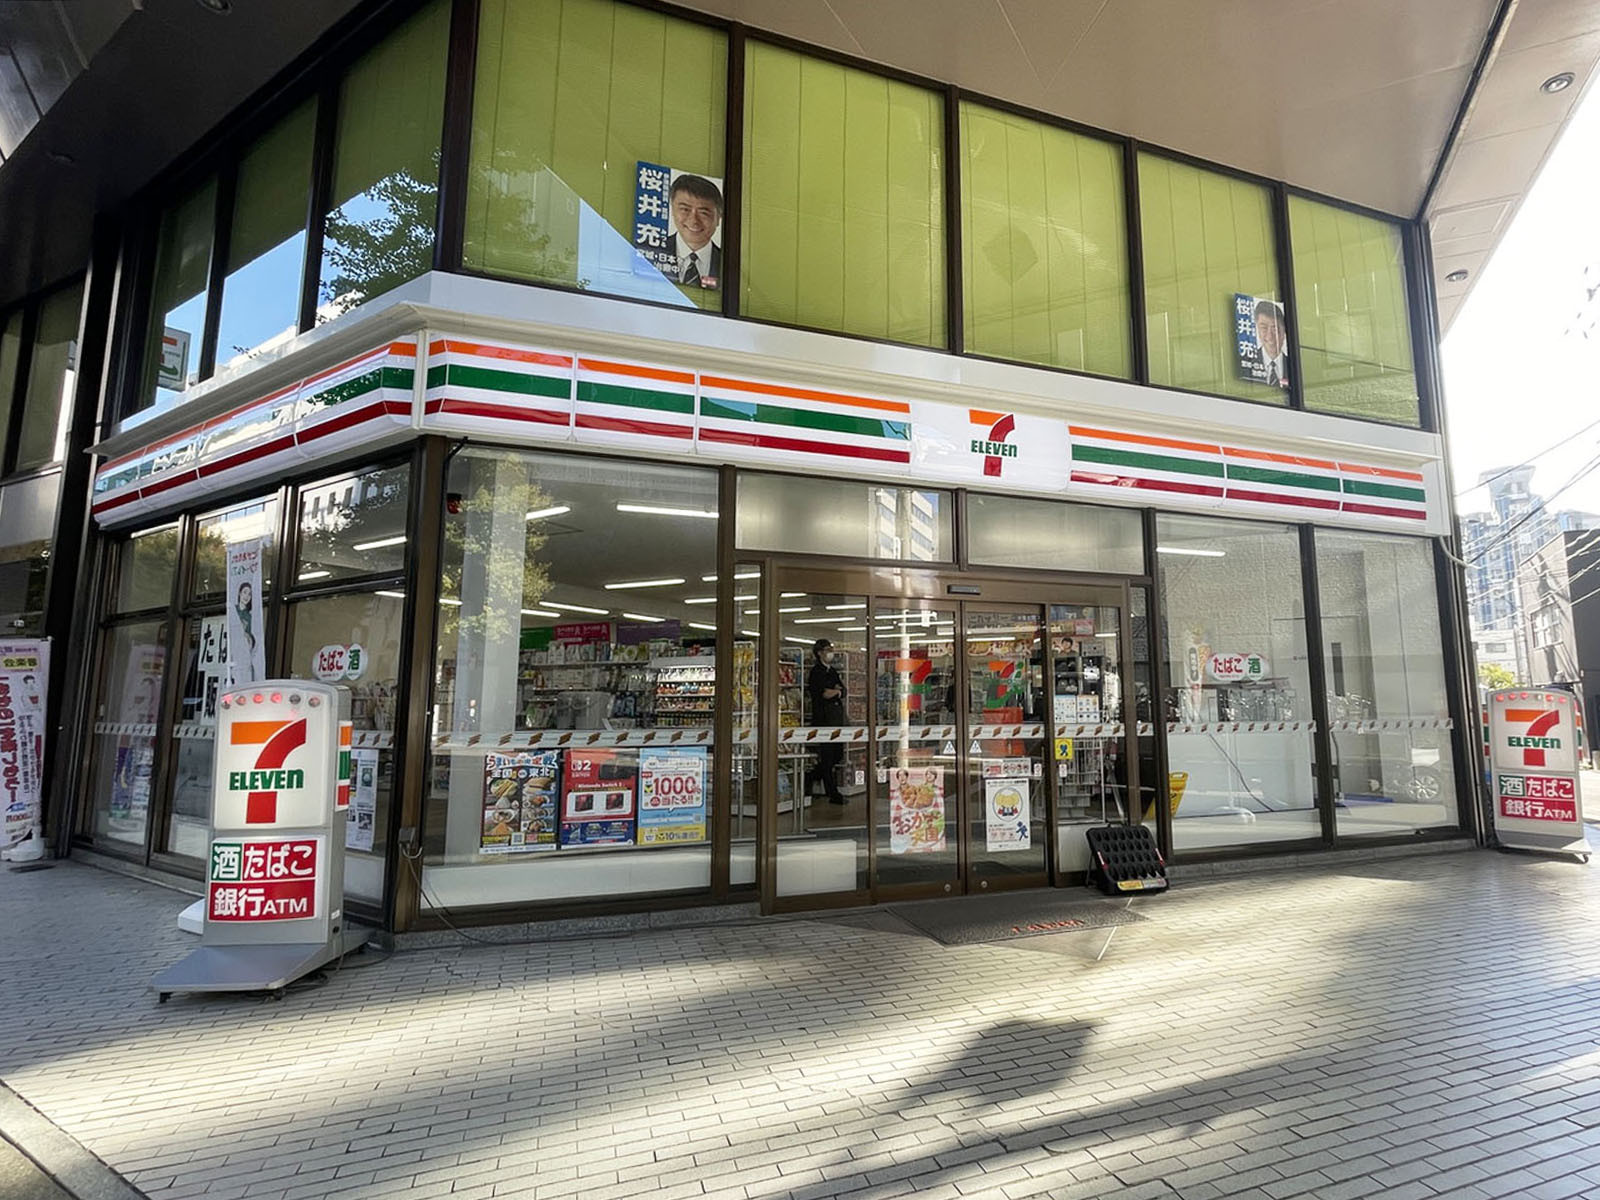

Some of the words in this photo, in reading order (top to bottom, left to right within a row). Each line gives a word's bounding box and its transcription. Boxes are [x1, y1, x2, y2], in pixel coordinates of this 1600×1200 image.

[637, 167, 663, 247] 桜井充
[1236, 297, 1254, 358] 桜井充
[318, 650, 344, 672] たばこ
[348, 648, 361, 671] 酒
[1213, 656, 1243, 674] たばこ
[1248, 657, 1261, 674] 酒
[1501, 776, 1523, 796] 酒
[1526, 778, 1574, 798] たばこ
[212, 845, 241, 879] 酒
[244, 842, 313, 878] たばこ
